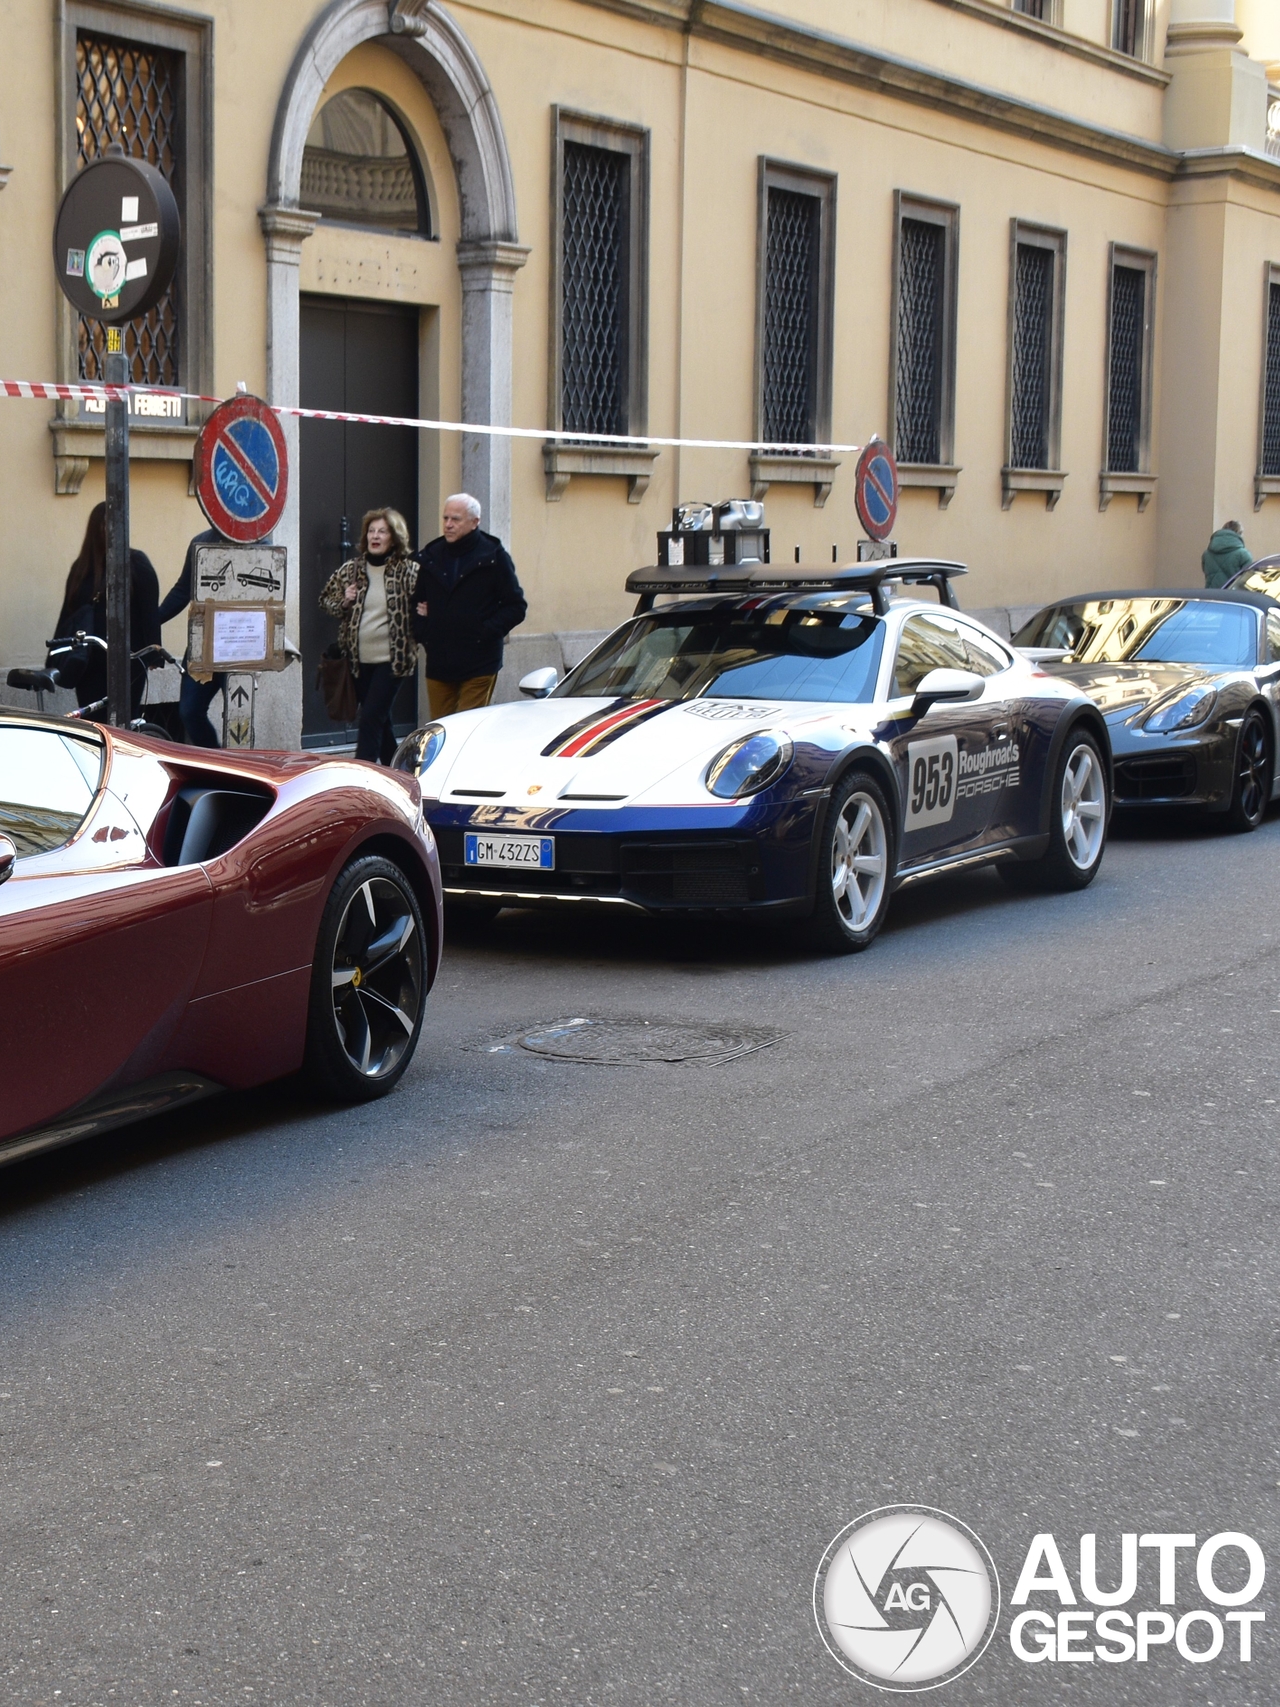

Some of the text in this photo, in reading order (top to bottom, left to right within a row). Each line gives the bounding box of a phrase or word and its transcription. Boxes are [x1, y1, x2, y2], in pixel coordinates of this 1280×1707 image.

[134, 393, 181, 418] FERRETTI
[958, 740, 1020, 776] Roughroads
[911, 751, 954, 815] 953
[956, 771, 1020, 800] PORSCHE
